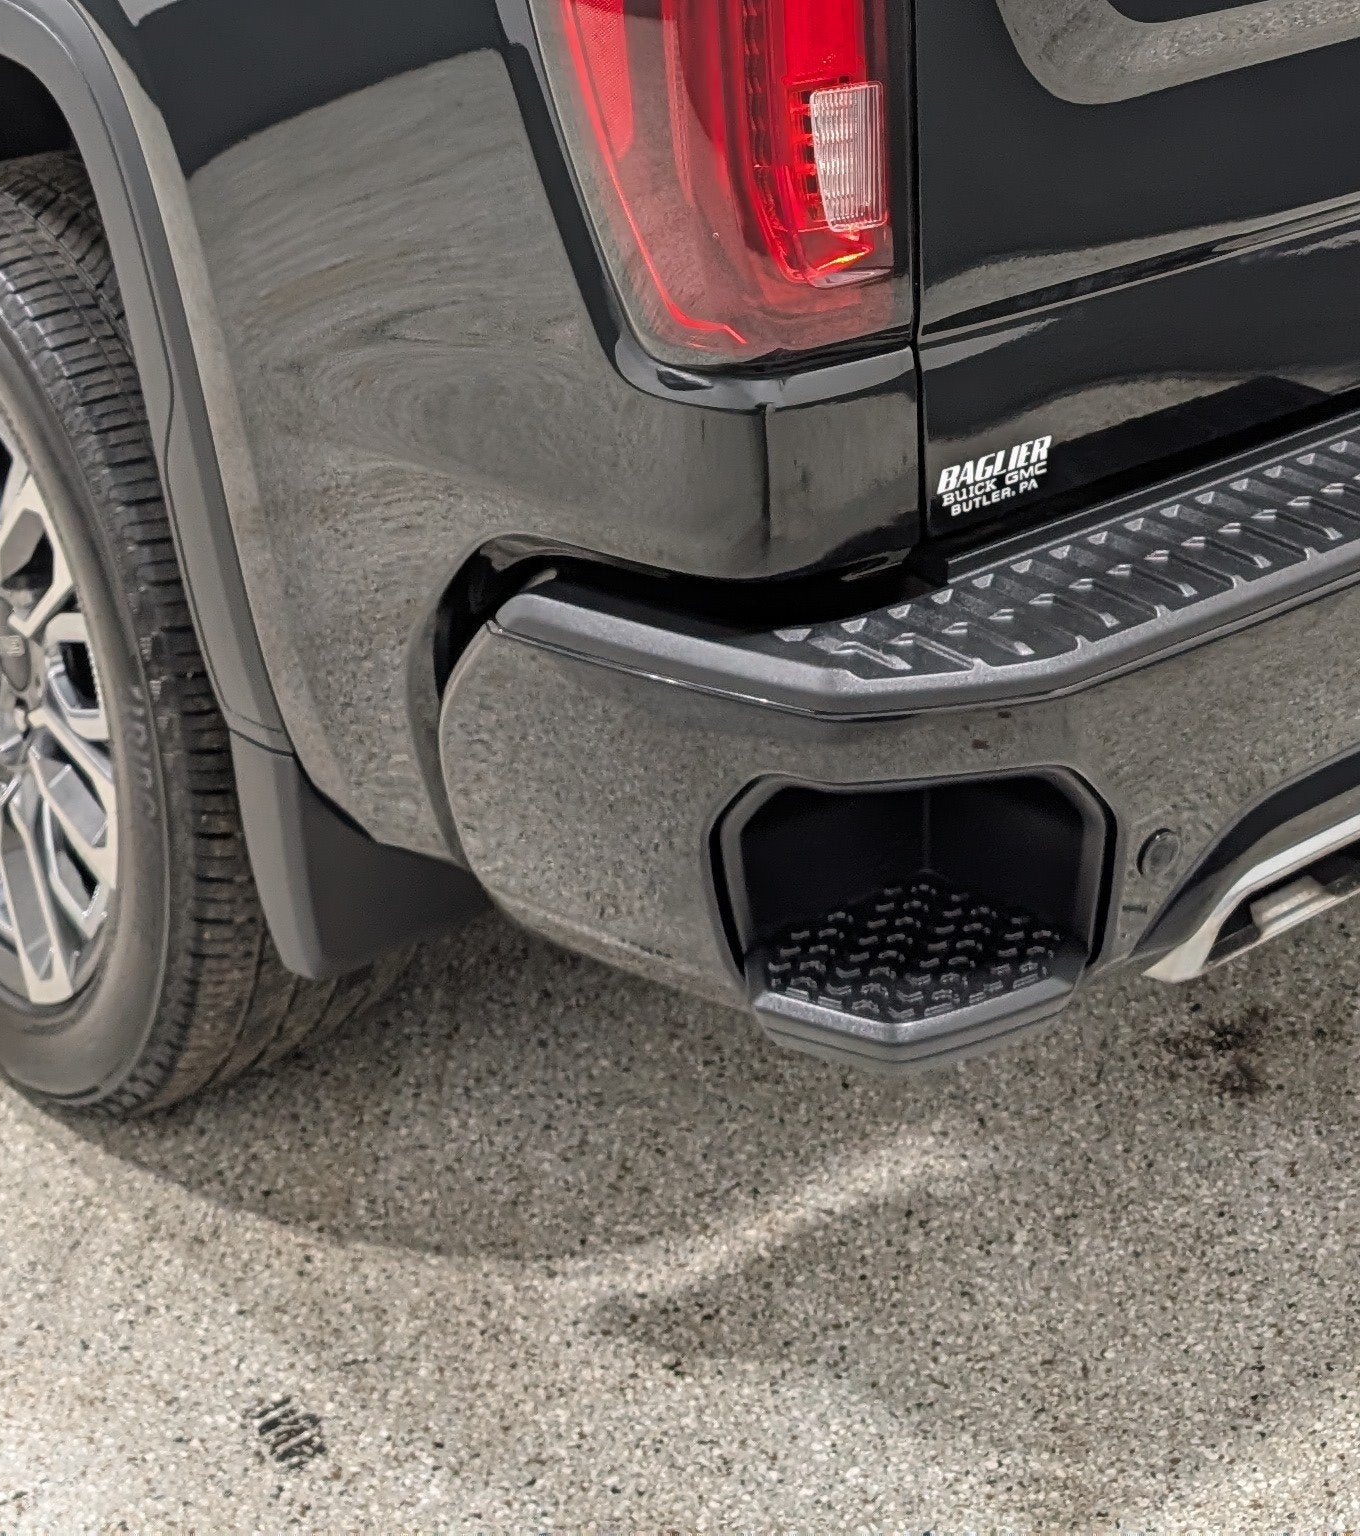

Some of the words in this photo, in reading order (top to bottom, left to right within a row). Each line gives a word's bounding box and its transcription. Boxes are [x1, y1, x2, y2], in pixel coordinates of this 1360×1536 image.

[937, 435, 1052, 494] BAGLIER
[943, 478, 997, 506] BUICK
[1005, 462, 1047, 484] GMC
[1019, 478, 1038, 494] PA
